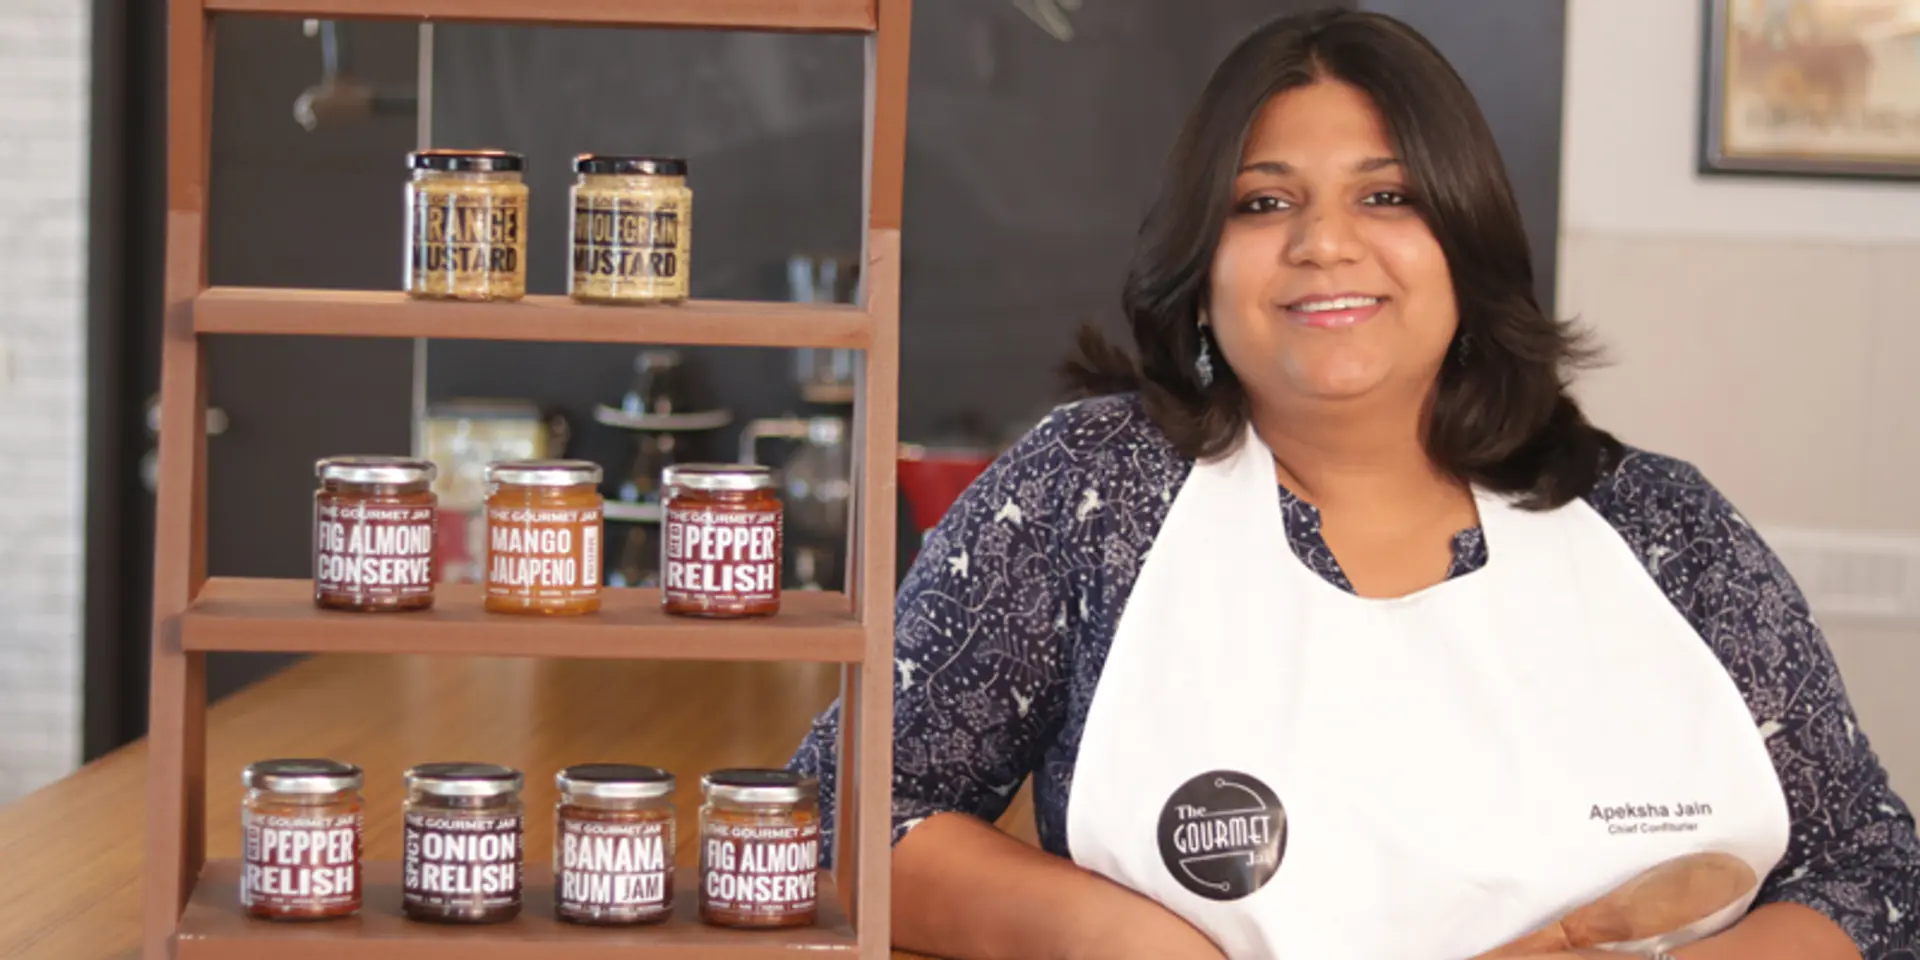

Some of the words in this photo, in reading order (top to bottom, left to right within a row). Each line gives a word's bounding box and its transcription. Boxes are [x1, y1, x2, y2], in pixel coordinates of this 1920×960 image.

[414, 207, 517, 242] RANGE
[319, 521, 345, 553] FIG
[348, 524, 431, 555] ALMOND
[492, 526, 571, 554] MANGO
[685, 525, 775, 561] PEPPER
[318, 554, 431, 585] CONSERVE
[490, 555, 576, 586] JALAPENO
[668, 561, 774, 592] RELISH
[425, 818, 494, 830] GOURMET
[1174, 804, 1206, 820] The
[1589, 802, 1670, 823] Apeksha
[1674, 801, 1713, 818] Jain
[262, 828, 354, 865] PEPPER
[422, 832, 516, 861] ONION
[732, 827, 799, 839] GOURMET
[1173, 815, 1270, 854] GOURMET
[406, 829, 420, 888] SPICY
[564, 832, 664, 872] BANANA
[708, 839, 735, 870] FIG
[247, 864, 354, 896] RELISH
[422, 862, 516, 894] RELISH
[562, 871, 611, 903] RUM
[624, 875, 661, 901] JAM
[707, 871, 816, 902] CONSERVE
